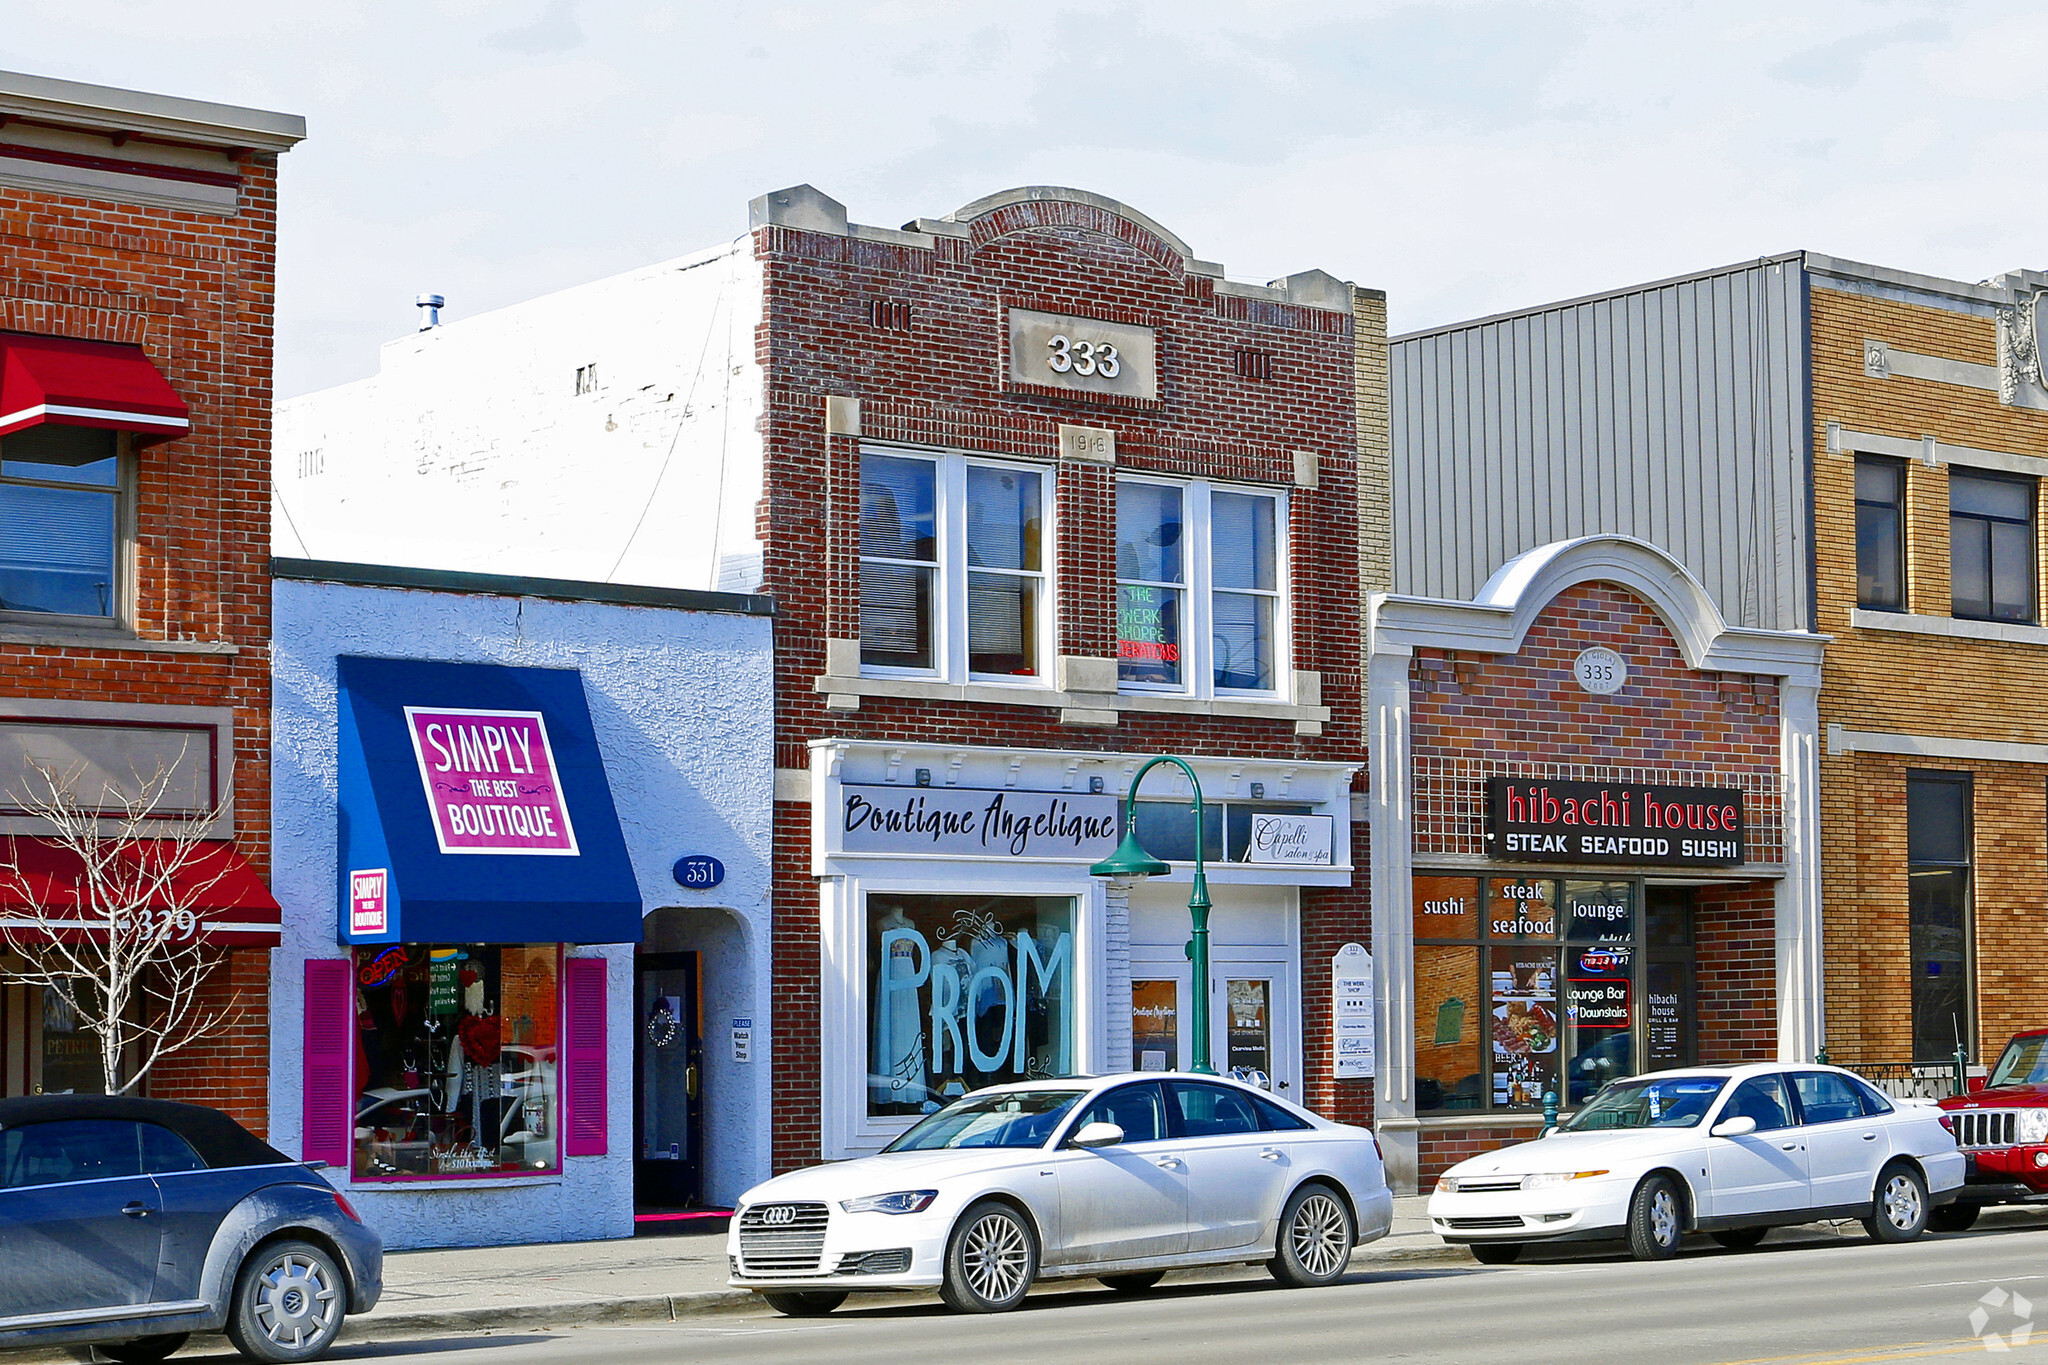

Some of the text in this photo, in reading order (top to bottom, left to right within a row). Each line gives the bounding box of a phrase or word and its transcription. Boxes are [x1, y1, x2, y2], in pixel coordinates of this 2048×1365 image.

[1046, 334, 1120, 378] 333
[1119, 608, 1161, 624] WERK
[1116, 623, 1167, 643] SHOPPE
[1583, 664, 1613, 681] 335
[426, 723, 534, 775] SIMPLY
[468, 779, 519, 798] THE BEST
[1506, 786, 1738, 831] hibachi house
[447, 804, 557, 838] BOUTIQUE
[845, 793, 1116, 856] Boutique Angelique
[1255, 818, 1307, 855] Capelli
[1506, 833, 1737, 858] STEAK SEAFOOD SUSHI
[1284, 847, 1308, 859] salon
[1314, 849, 1329, 862] spa
[687, 861, 714, 882] 331
[354, 876, 383, 899] SIMPLY
[1503, 883, 1543, 899] steak
[1424, 897, 1624, 921] sushi lounge
[1519, 902, 1528, 913] &
[137, 909, 197, 941] 329
[354, 911, 383, 927] BOUTIQUE
[1492, 916, 1555, 934] seafood
[360, 946, 409, 985] OPEN
[881, 928, 1071, 1074] PROM
[1566, 986, 1626, 1003] Lounge Bar
[1648, 994, 1677, 1004] hibachi
[1580, 1005, 1628, 1018] Downstairs
[1651, 1005, 1675, 1016] house
